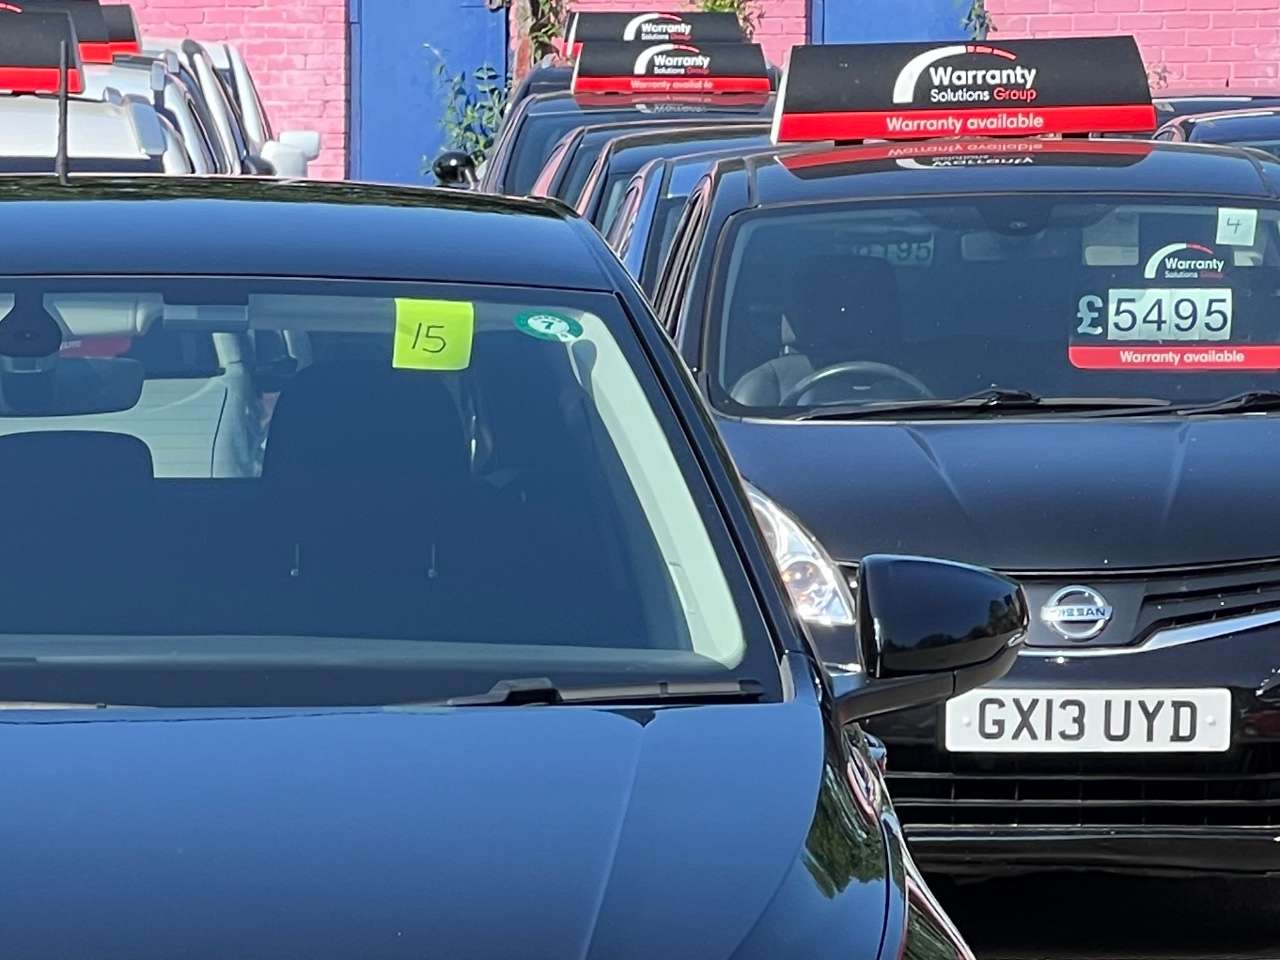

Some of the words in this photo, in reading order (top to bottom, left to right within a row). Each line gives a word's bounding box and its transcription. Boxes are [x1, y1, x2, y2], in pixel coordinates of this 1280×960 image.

[641, 23, 691, 35] Warranty
[654, 55, 710, 69] Warranty
[929, 66, 1036, 89] Warranty
[930, 88, 990, 102] Solutions
[993, 88, 1036, 102] Group
[886, 116, 963, 133] Warranty
[967, 113, 1044, 129] available
[1226, 216, 1243, 234] 4
[1165, 257, 1224, 272] Warranty
[412, 322, 447, 353] 15
[1120, 350, 1181, 366] Warranty
[1184, 350, 1246, 363] available
[1051, 607, 1107, 617] ISSAN
[978, 697, 1086, 741] GX13
[1103, 699, 1198, 742] UYD
